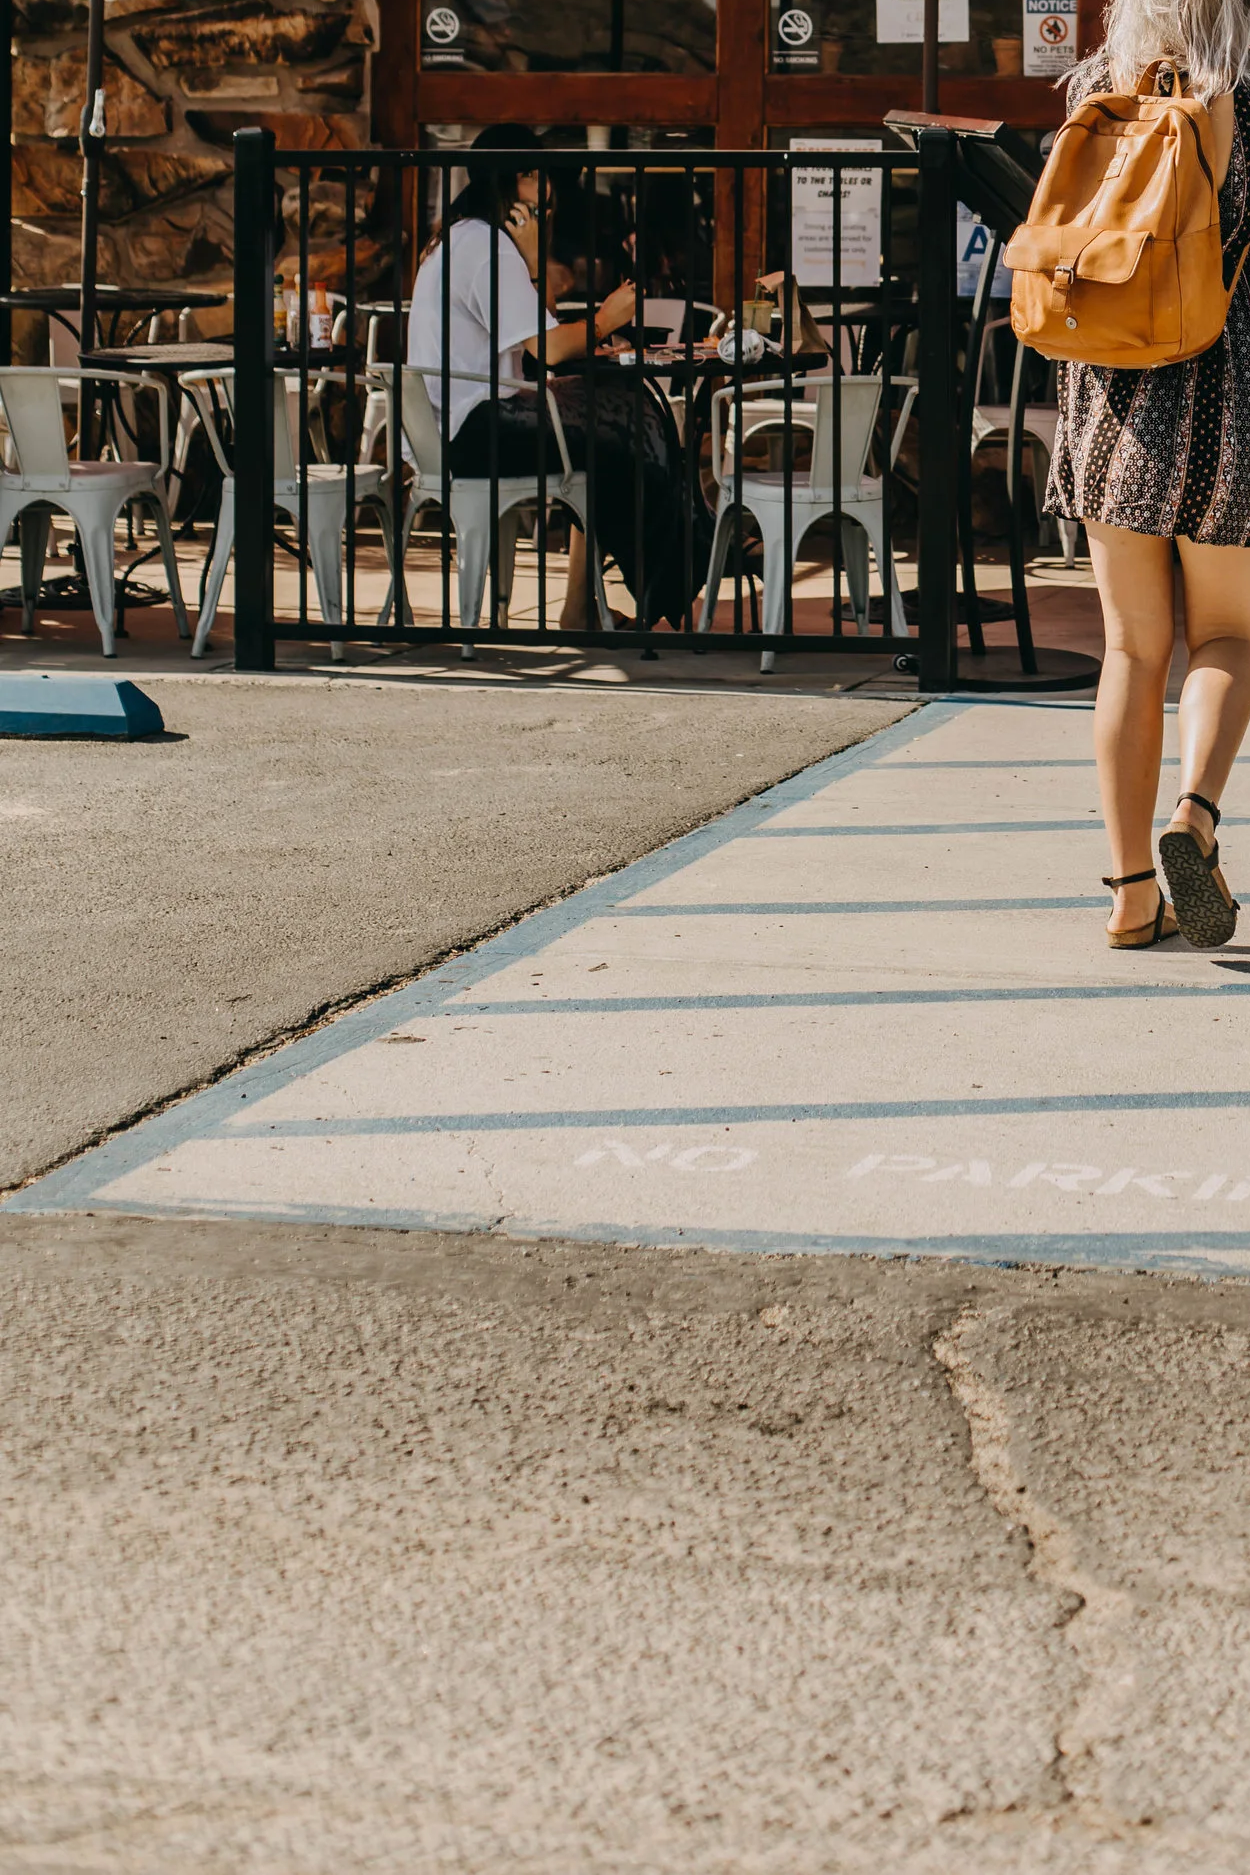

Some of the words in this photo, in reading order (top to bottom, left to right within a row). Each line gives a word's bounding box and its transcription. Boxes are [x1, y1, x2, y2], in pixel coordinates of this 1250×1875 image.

[1028, 0, 1077, 12] NOTICE
[1033, 46, 1047, 54] NO
[1051, 46, 1075, 54] PETS
[962, 226, 988, 262] A
[571, 1138, 759, 1174] NO
